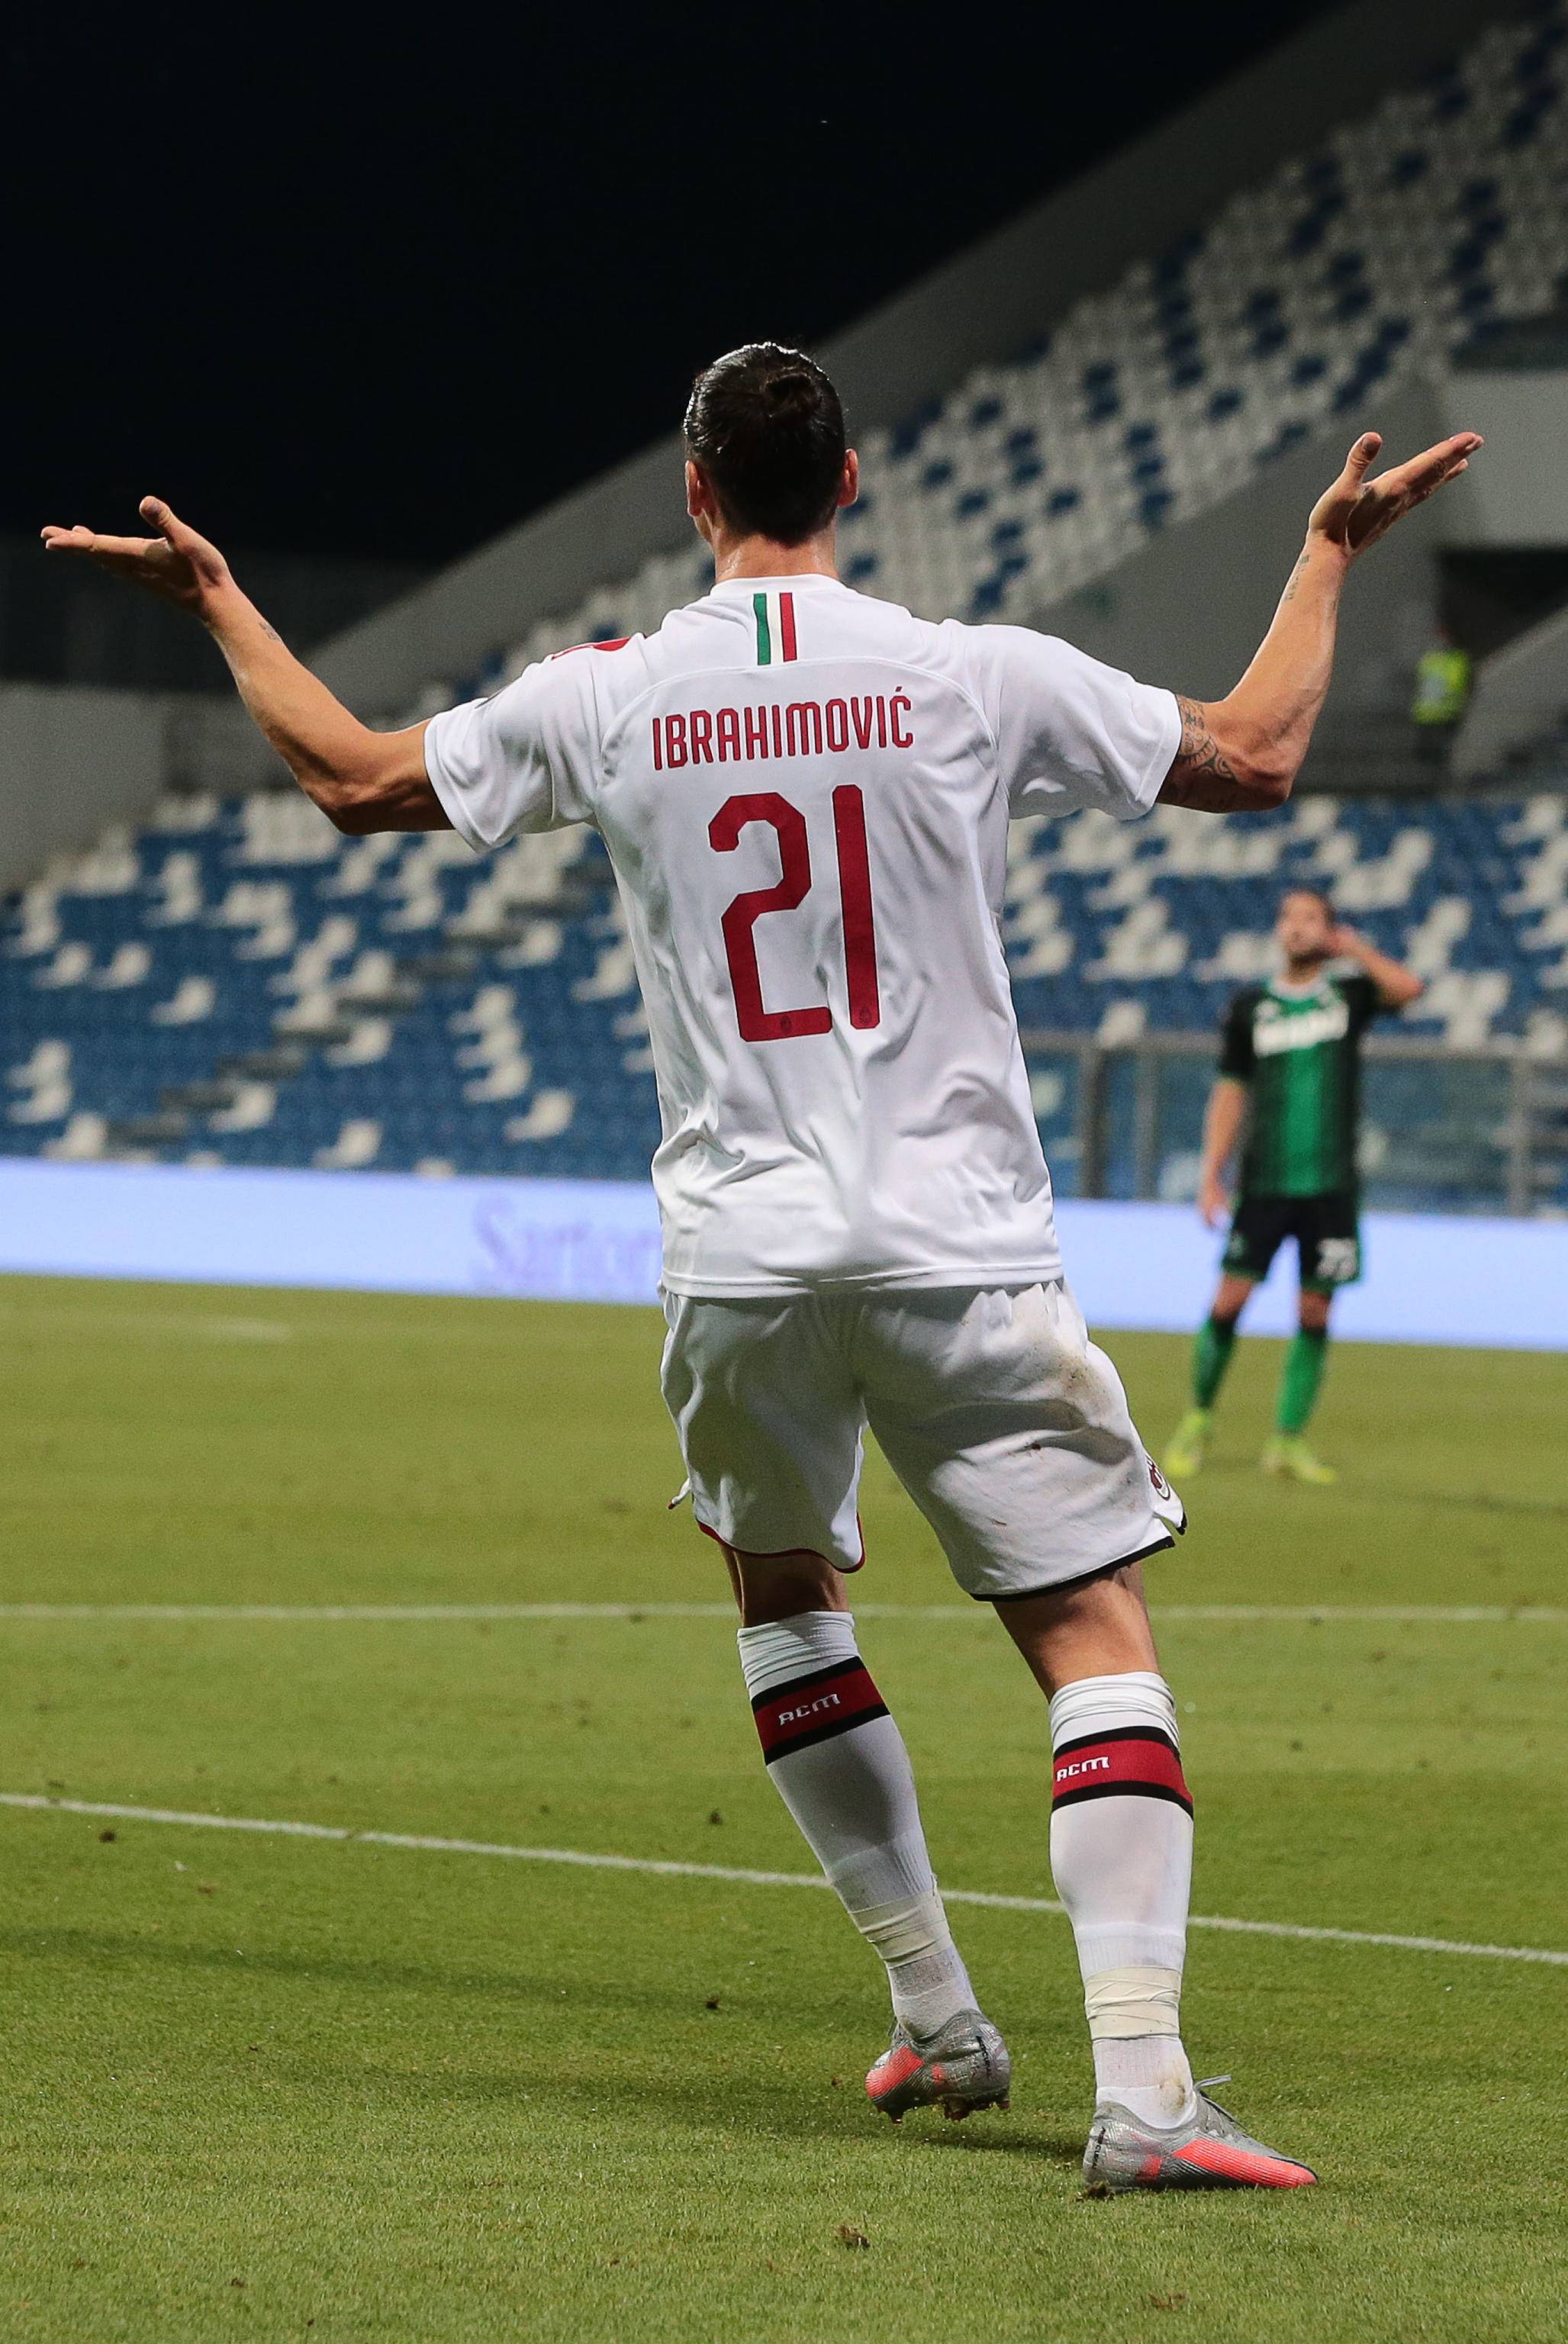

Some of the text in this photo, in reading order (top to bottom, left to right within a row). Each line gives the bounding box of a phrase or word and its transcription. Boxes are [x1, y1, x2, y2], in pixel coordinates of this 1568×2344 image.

[652, 686, 913, 770] IBRAHIMOVIĆ
[708, 784, 881, 1042] 21
[778, 1693, 840, 1726] ACM
[1056, 1756, 1110, 1782] ACM
